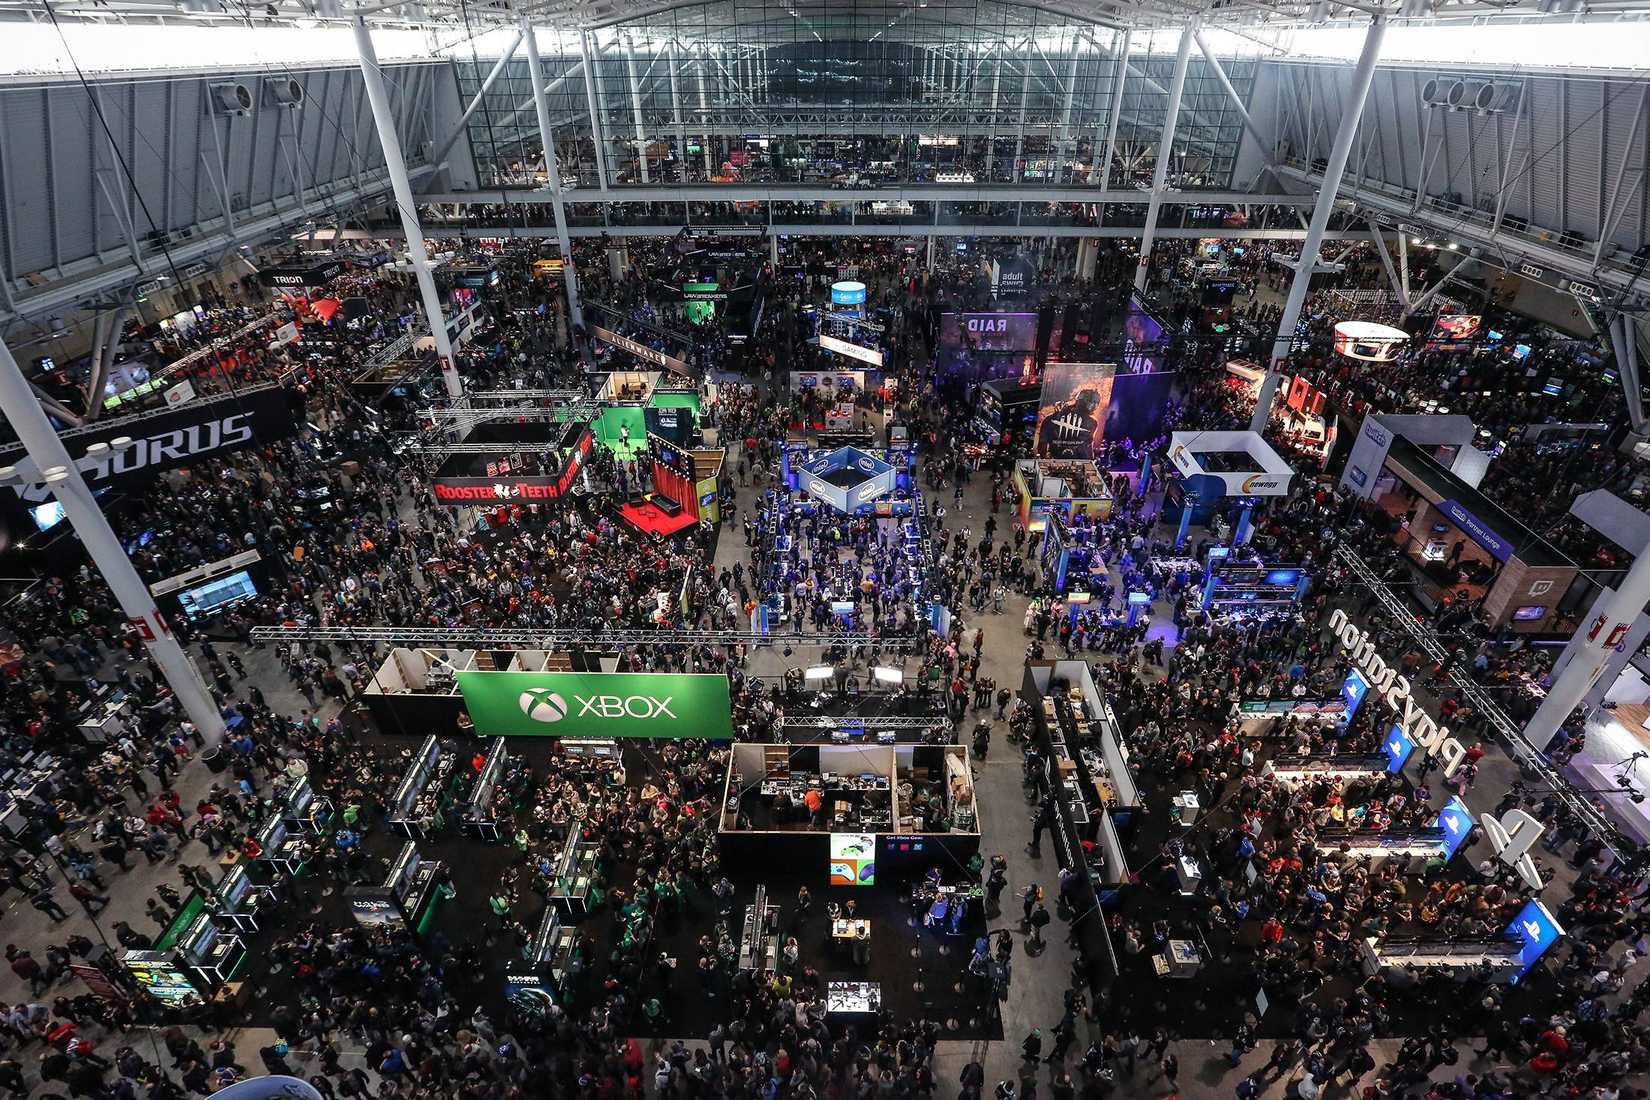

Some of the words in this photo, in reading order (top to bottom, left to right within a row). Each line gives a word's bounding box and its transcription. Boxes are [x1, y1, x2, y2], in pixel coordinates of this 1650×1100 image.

[611, 336, 660, 362] ALIENWARE
[434, 483, 496, 500] ROOSTER
[516, 482, 558, 499] TEETH
[1249, 480, 1279, 489] newegg
[574, 694, 677, 720] XBOX
